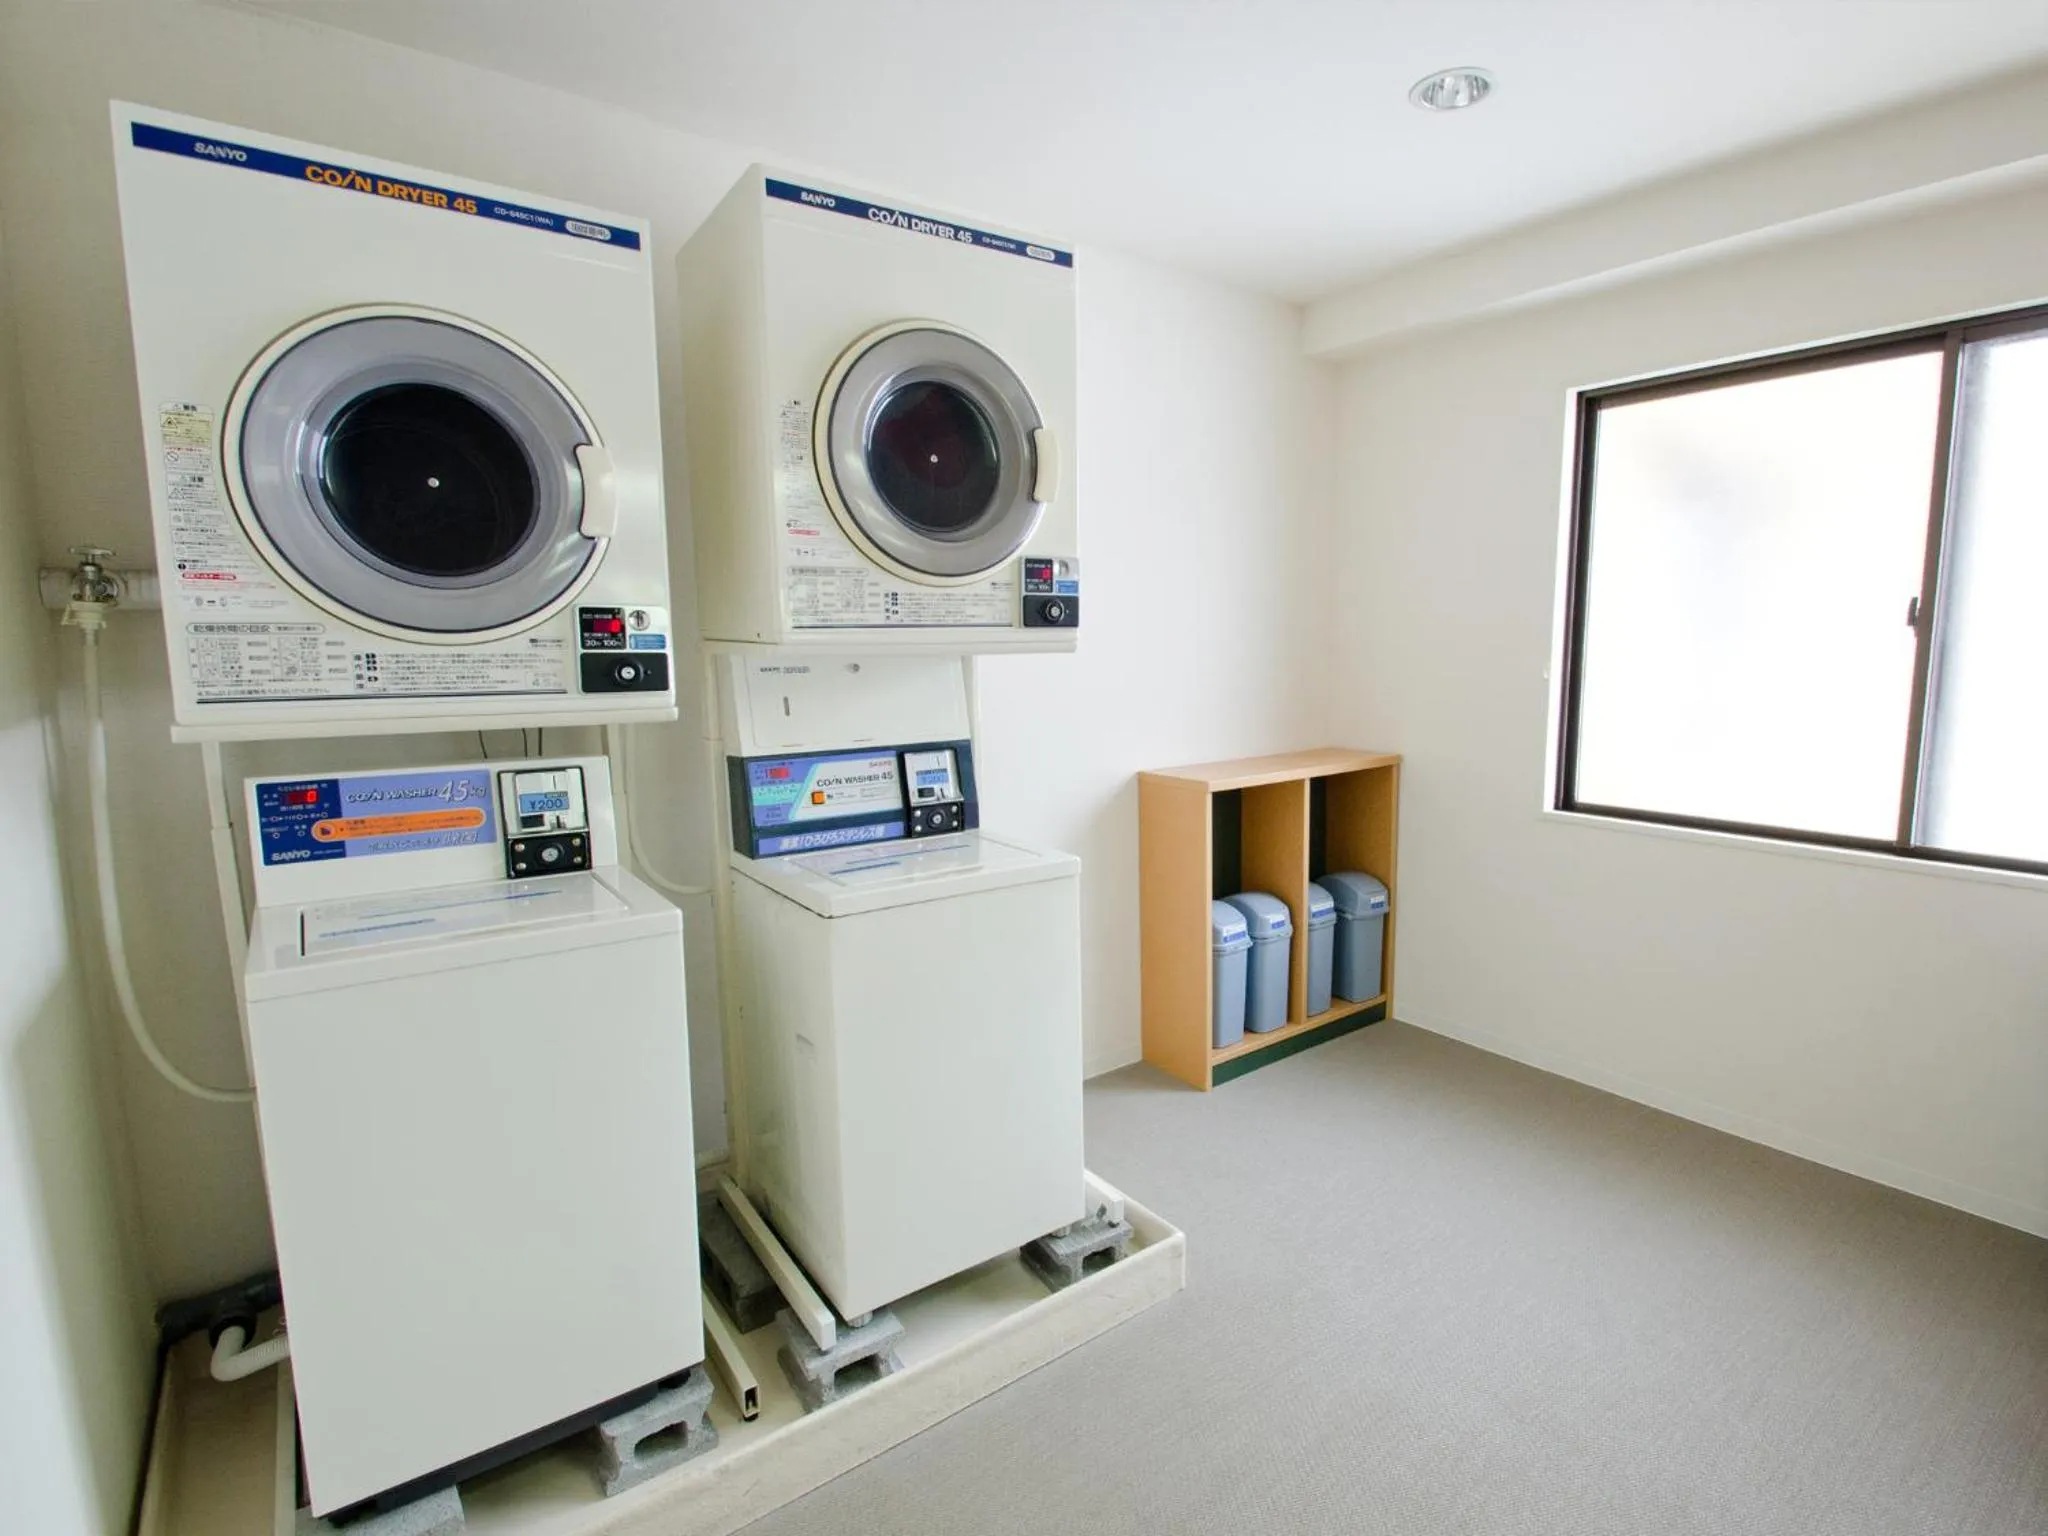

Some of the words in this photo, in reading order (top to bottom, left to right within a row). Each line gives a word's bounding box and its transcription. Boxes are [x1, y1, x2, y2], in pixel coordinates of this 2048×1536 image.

[194, 142, 247, 161] SANYO
[377, 180, 448, 208] DRYER
[453, 197, 477, 214] 45
[801, 191, 836, 207] SANYO
[911, 218, 955, 240] DRYER
[957, 230, 973, 243] 45
[844, 774, 879, 784] WASHER
[386, 787, 438, 799] WASHER
[530, 798, 563, 810] ¥200
[271, 849, 311, 861] SANYO
